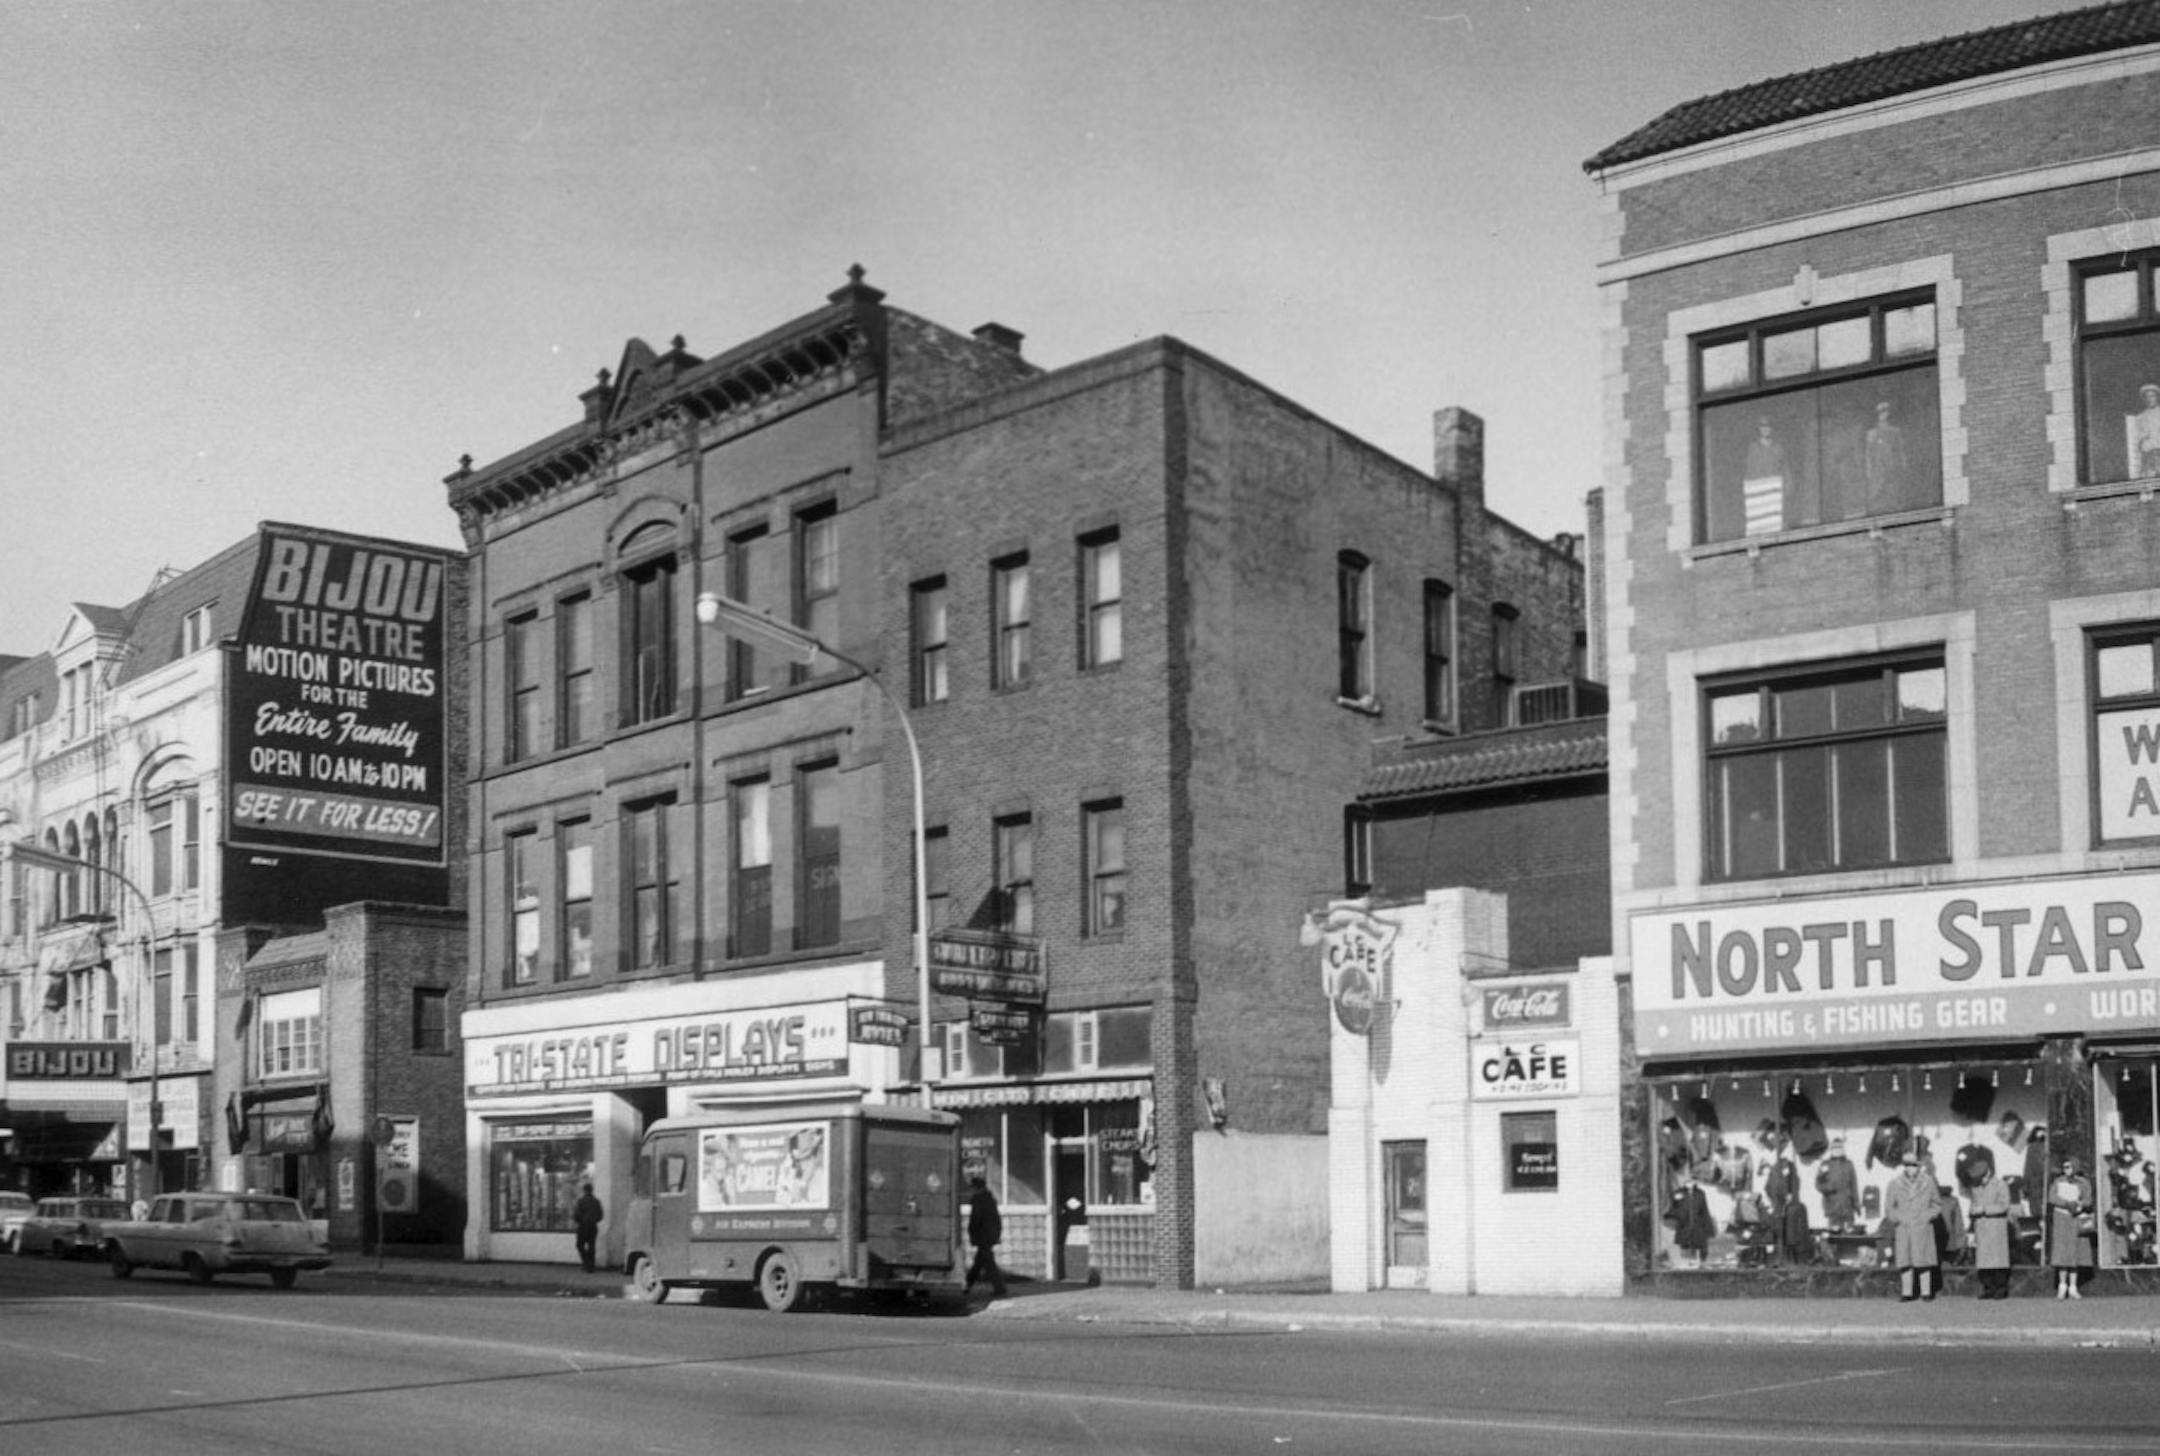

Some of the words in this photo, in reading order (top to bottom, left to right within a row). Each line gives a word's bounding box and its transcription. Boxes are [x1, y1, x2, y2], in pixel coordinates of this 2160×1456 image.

[261, 537, 442, 622] BIJOU
[275, 605, 424, 662] THEATRE
[246, 644, 328, 682] MOTION
[339, 657, 435, 696] PICTURES
[301, 684, 333, 705] FOR
[337, 687, 368, 709] THE
[254, 701, 331, 739] Entire
[334, 712, 419, 758] Family
[250, 746, 301, 777] OPEN
[363, 763, 380, 786] to
[234, 791, 282, 822] SEE
[285, 797, 315, 824] IT
[320, 801, 361, 829] FOR
[364, 804, 436, 838] LESS!
[1330, 944, 1376, 973] CAFE
[1671, 919, 1896, 1000] NORTH
[1938, 899, 2144, 982] STAR
[1691, 1007, 1794, 1041] HUNTING
[1804, 1013, 1817, 1041] &
[1824, 1001, 1924, 1035] FISHING
[1937, 997, 2007, 1028] GEAR
[2090, 988, 2157, 1019] WOR
[13, 1049, 116, 1075] BIJOU
[494, 1031, 630, 1084] TRI-STATE
[654, 1016, 805, 1071] DISPLAYS
[1482, 1056, 1566, 1083] CAFE
[1505, 1046, 1521, 1057] L
[1530, 1044, 1546, 1055] C
